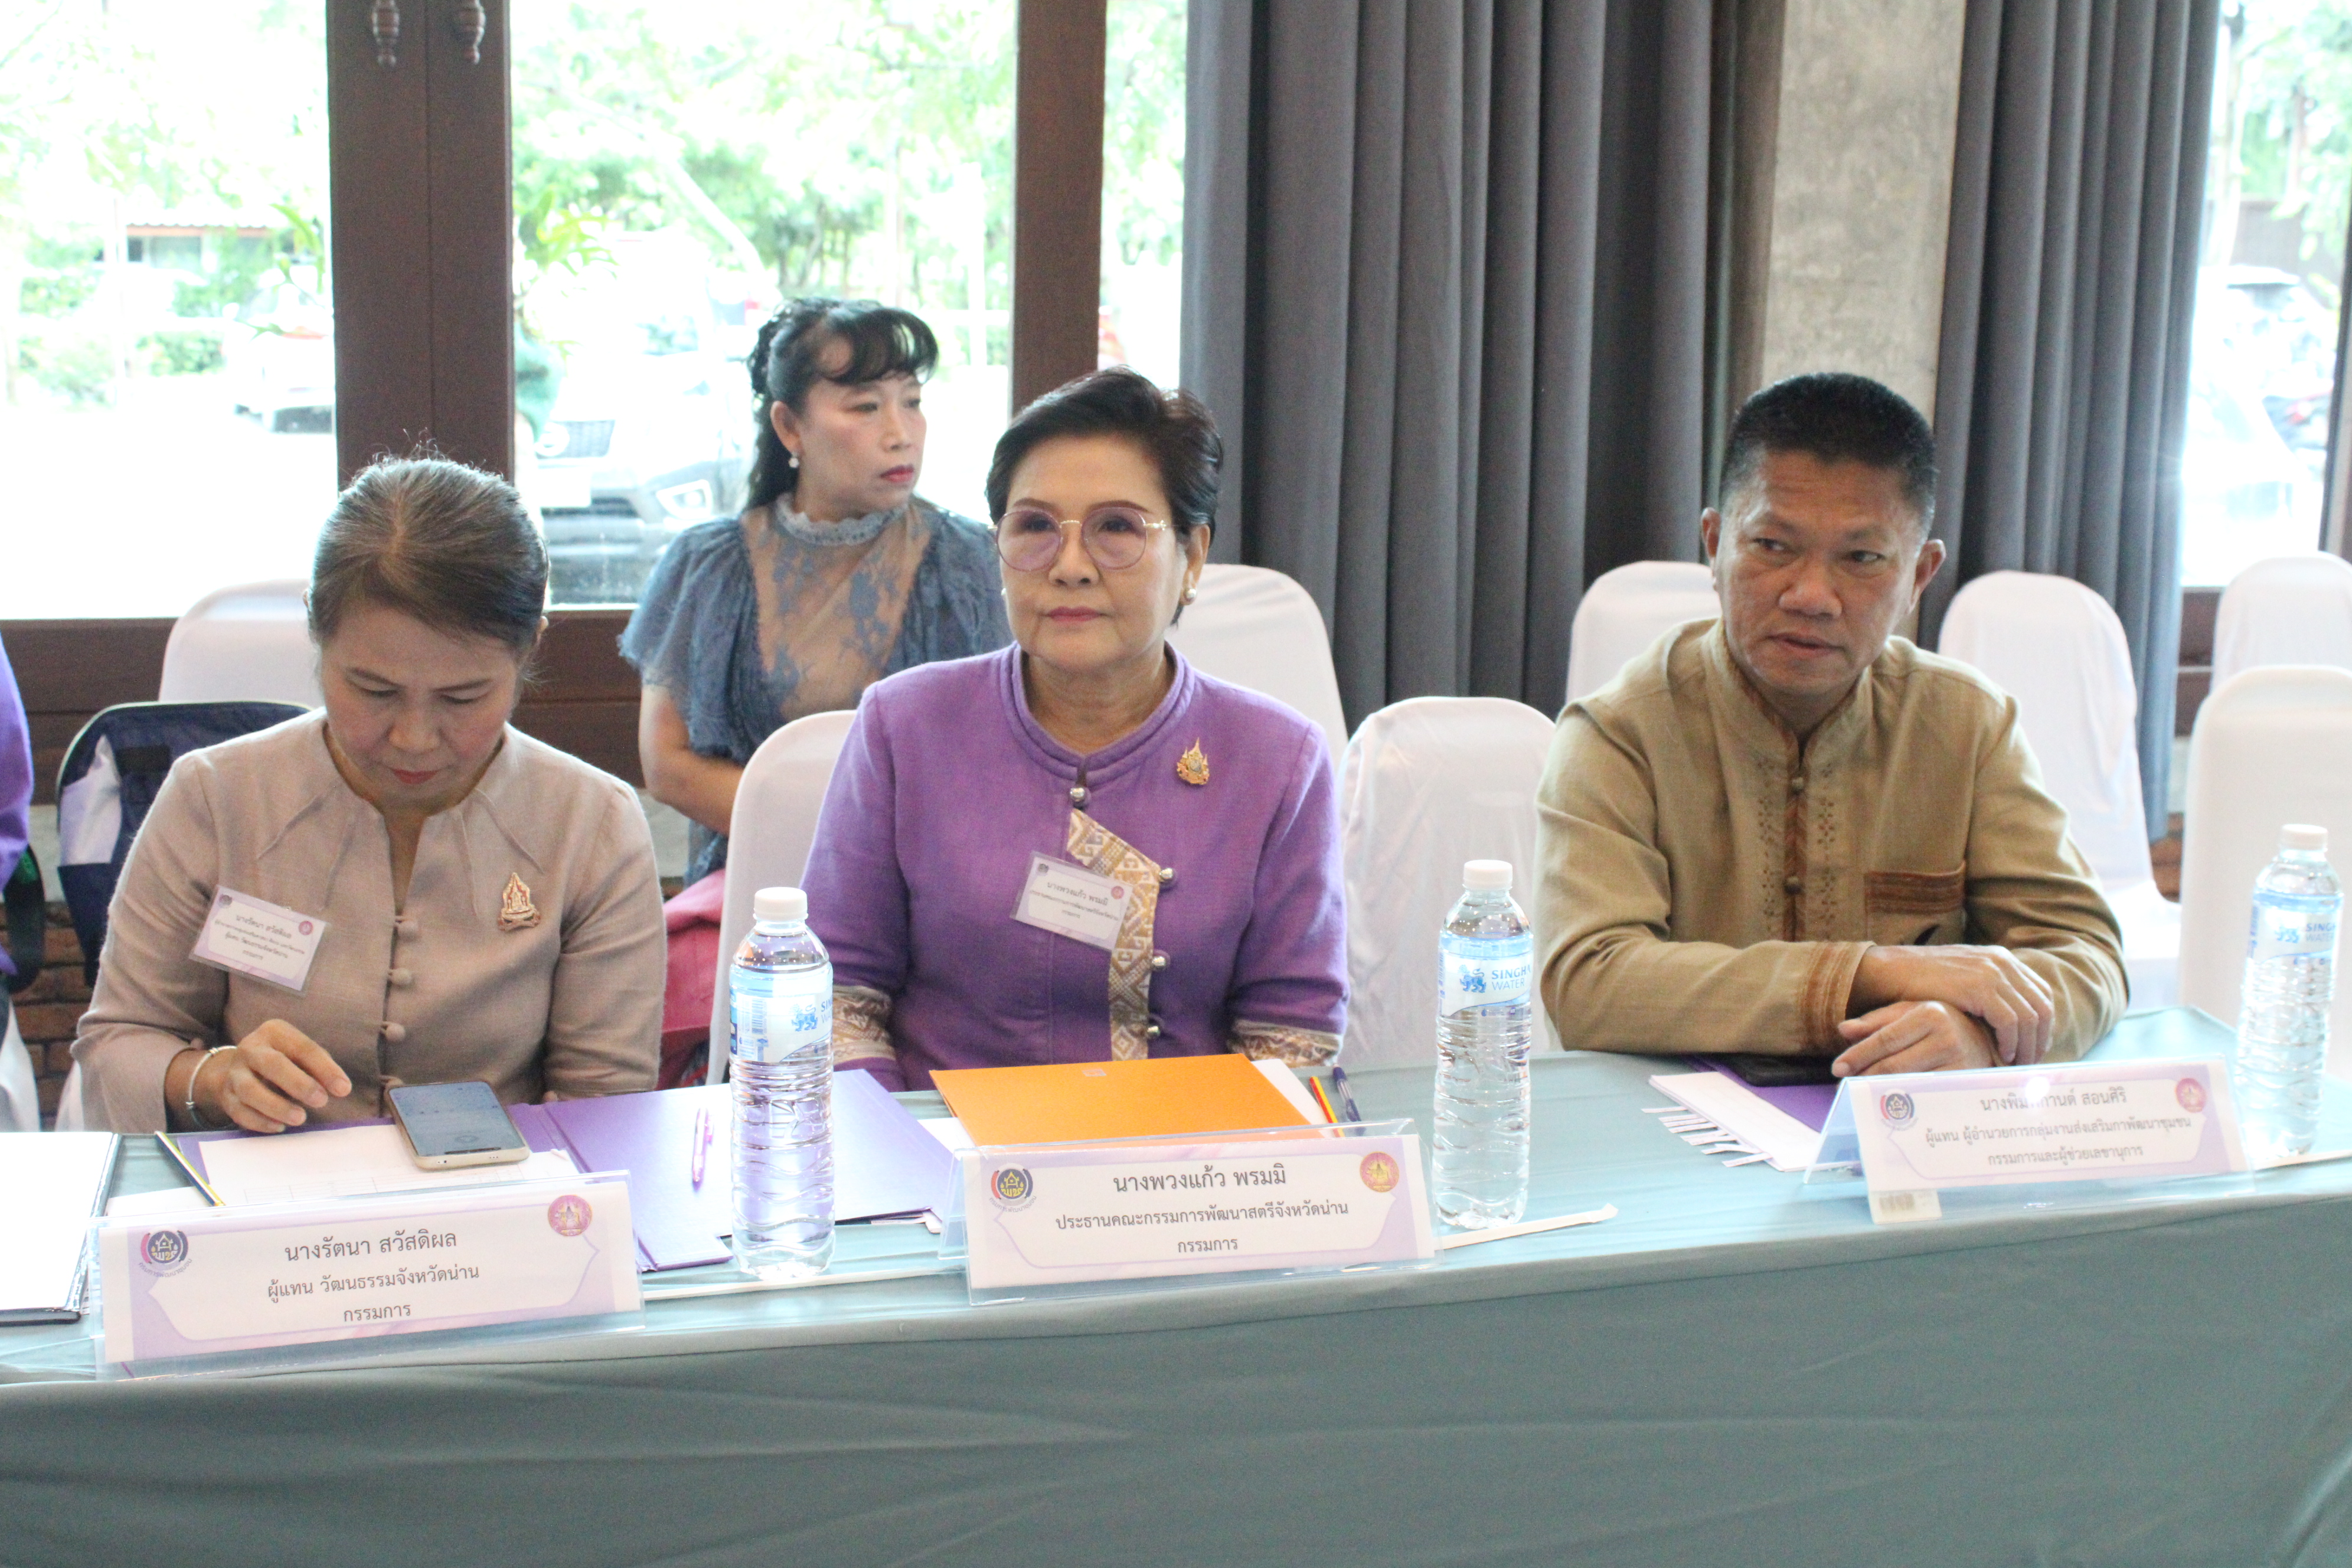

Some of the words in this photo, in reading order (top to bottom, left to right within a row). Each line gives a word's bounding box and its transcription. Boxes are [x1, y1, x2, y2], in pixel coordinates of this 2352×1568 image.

[1492, 978, 1525, 991] WATER
[1981, 1089, 2077, 1112] นางพิมกานต์
[2082, 1085, 2128, 1106] สอนศิริ
[1926, 1127, 1960, 1148] ผู้แทน
[1988, 1145, 2144, 1166] กรรมการและผู้ช่วยเลขานุการ
[1113, 1165, 1226, 1192] นางพวงแก้ว
[1233, 1163, 1286, 1185] พรมมิ
[1056, 1200, 1349, 1230] ประธานคณะกรรมการพัฒนาสตรีจังหวัดน่าน
[285, 1236, 371, 1261] นางรัตนา
[379, 1228, 457, 1253] สวัสดิผล
[1177, 1237, 1238, 1253] กรรมการ
[268, 1279, 313, 1304] ผู้แทน
[320, 1264, 479, 1292] วัฒนธรรมจังหวัดน่าน
[344, 1304, 411, 1322] กรรมการ
